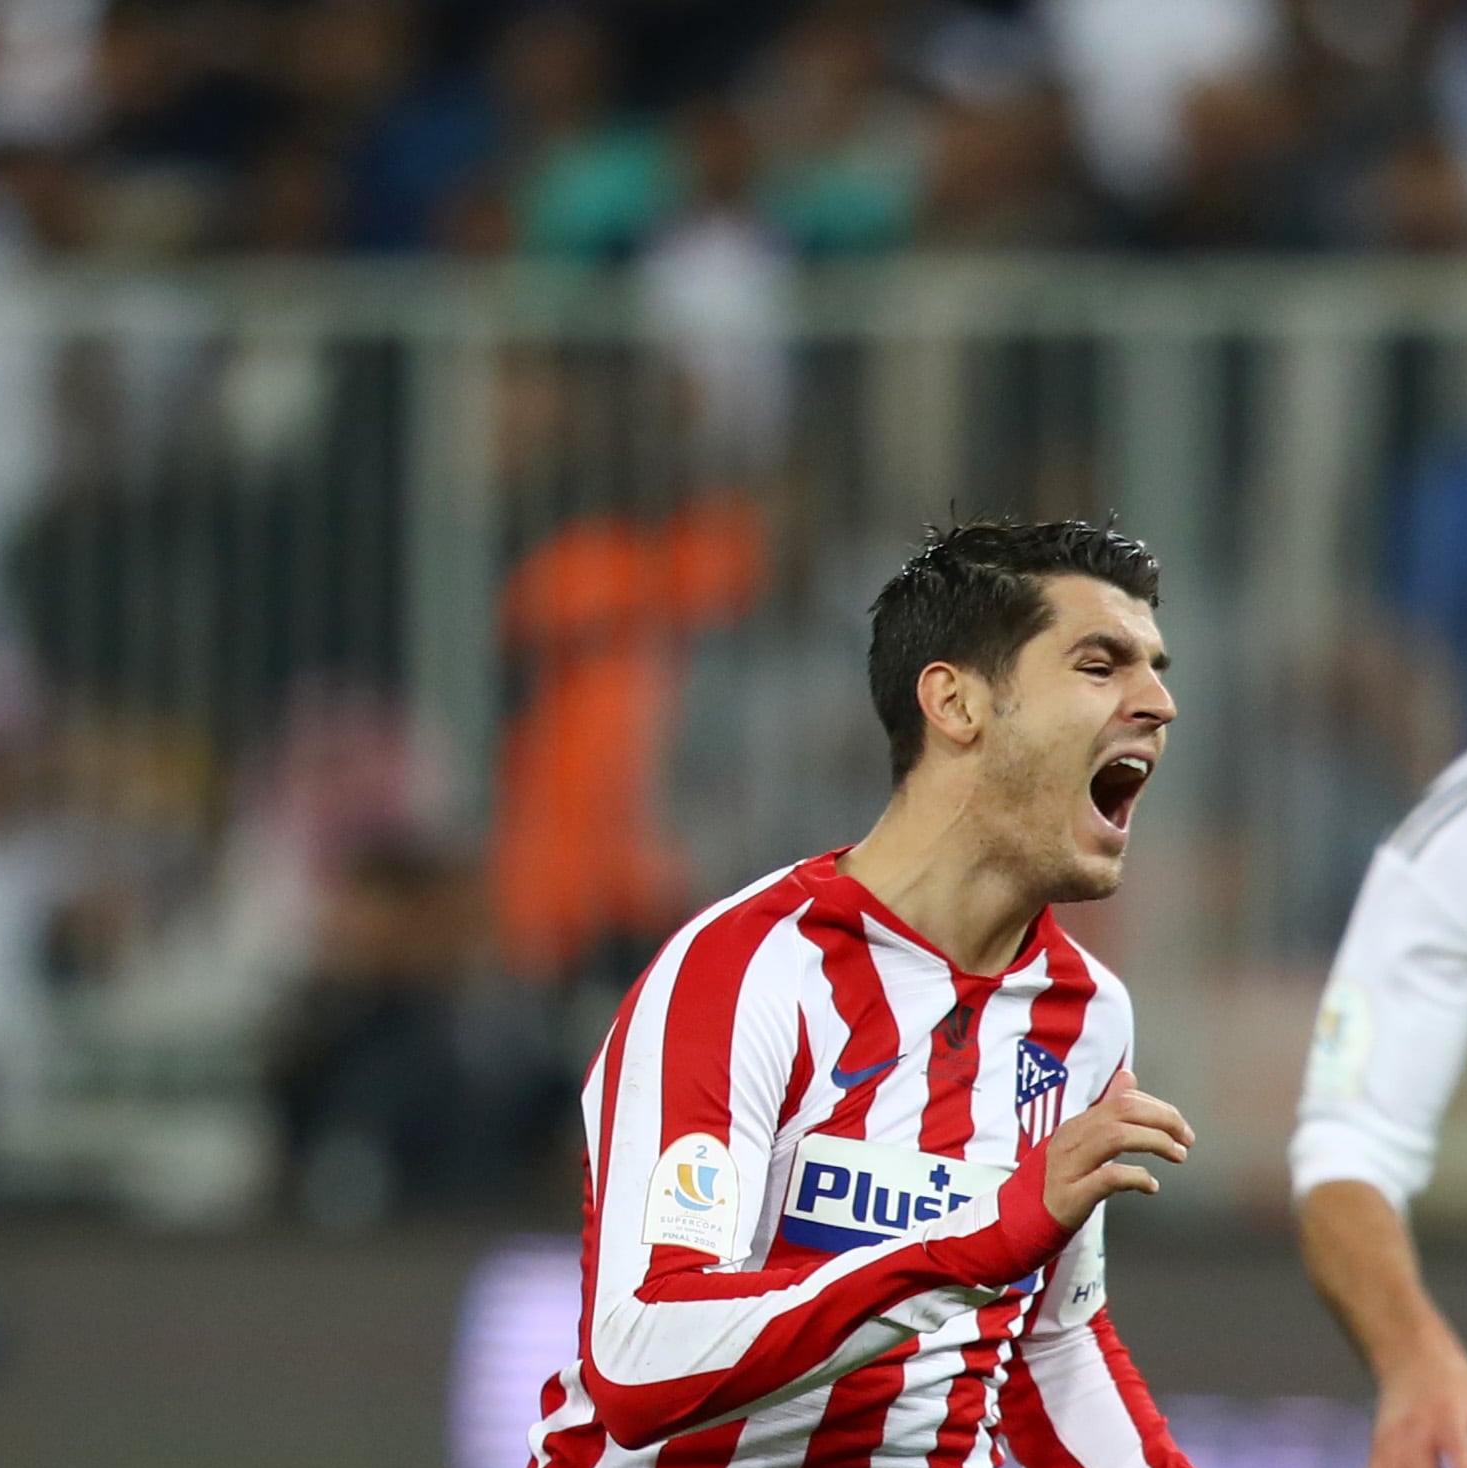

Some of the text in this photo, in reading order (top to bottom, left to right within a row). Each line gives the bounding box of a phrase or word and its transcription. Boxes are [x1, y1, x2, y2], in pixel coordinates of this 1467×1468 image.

[694, 1144, 709, 1160] 2
[659, 1215, 723, 1233] SUPERCOPA
[662, 1231, 717, 1249] FINAL 2020
